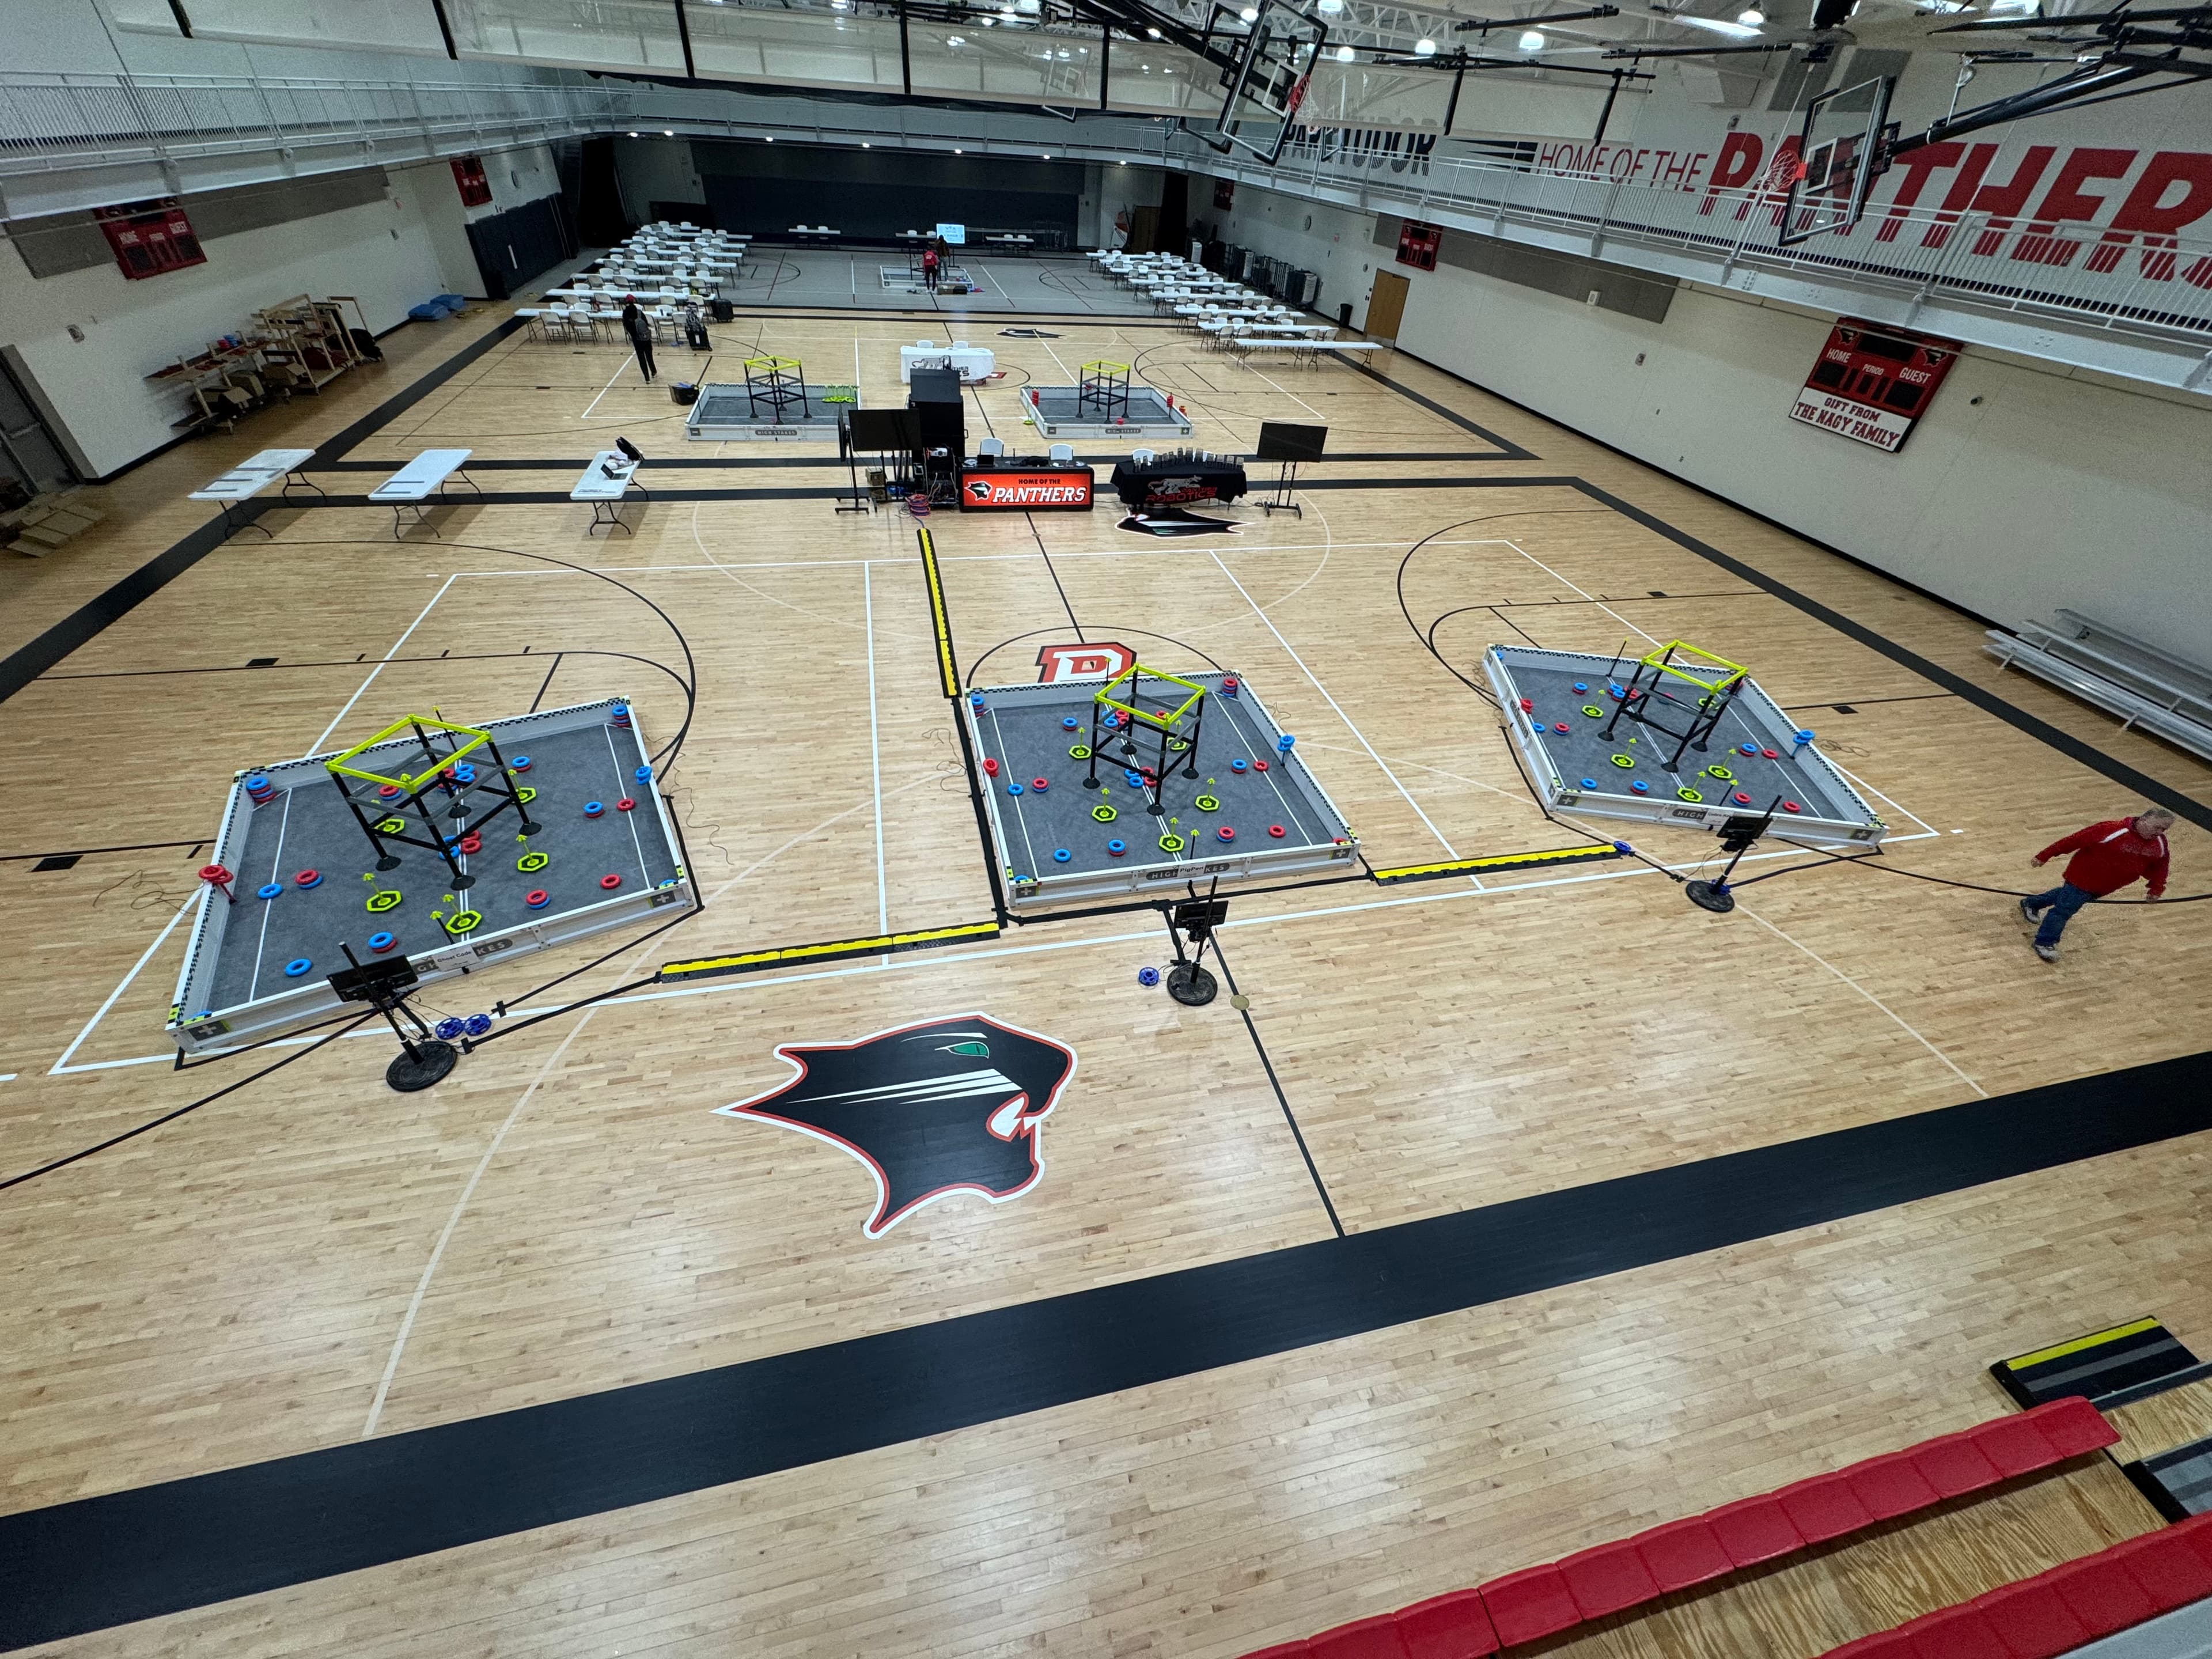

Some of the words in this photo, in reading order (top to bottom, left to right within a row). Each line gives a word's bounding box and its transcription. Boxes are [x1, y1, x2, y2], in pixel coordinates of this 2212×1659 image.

[1537, 143, 1609, 180] HOME
[1610, 148, 1650, 185] OF
[1650, 150, 1709, 192] THE
[1696, 131, 2212, 291] PANTHER
[1827, 348, 1851, 363] HOME
[1862, 363, 1884, 376] PERIOD
[1899, 368, 1931, 384] GUEST
[1824, 397, 1850, 411] GIFT
[1849, 405, 1881, 422] FROM
[1794, 402, 1819, 420] THE
[1816, 409, 1853, 432] NAGY
[1850, 421, 1900, 448] FAMILY
[992, 487, 1087, 503] PANTHERS
